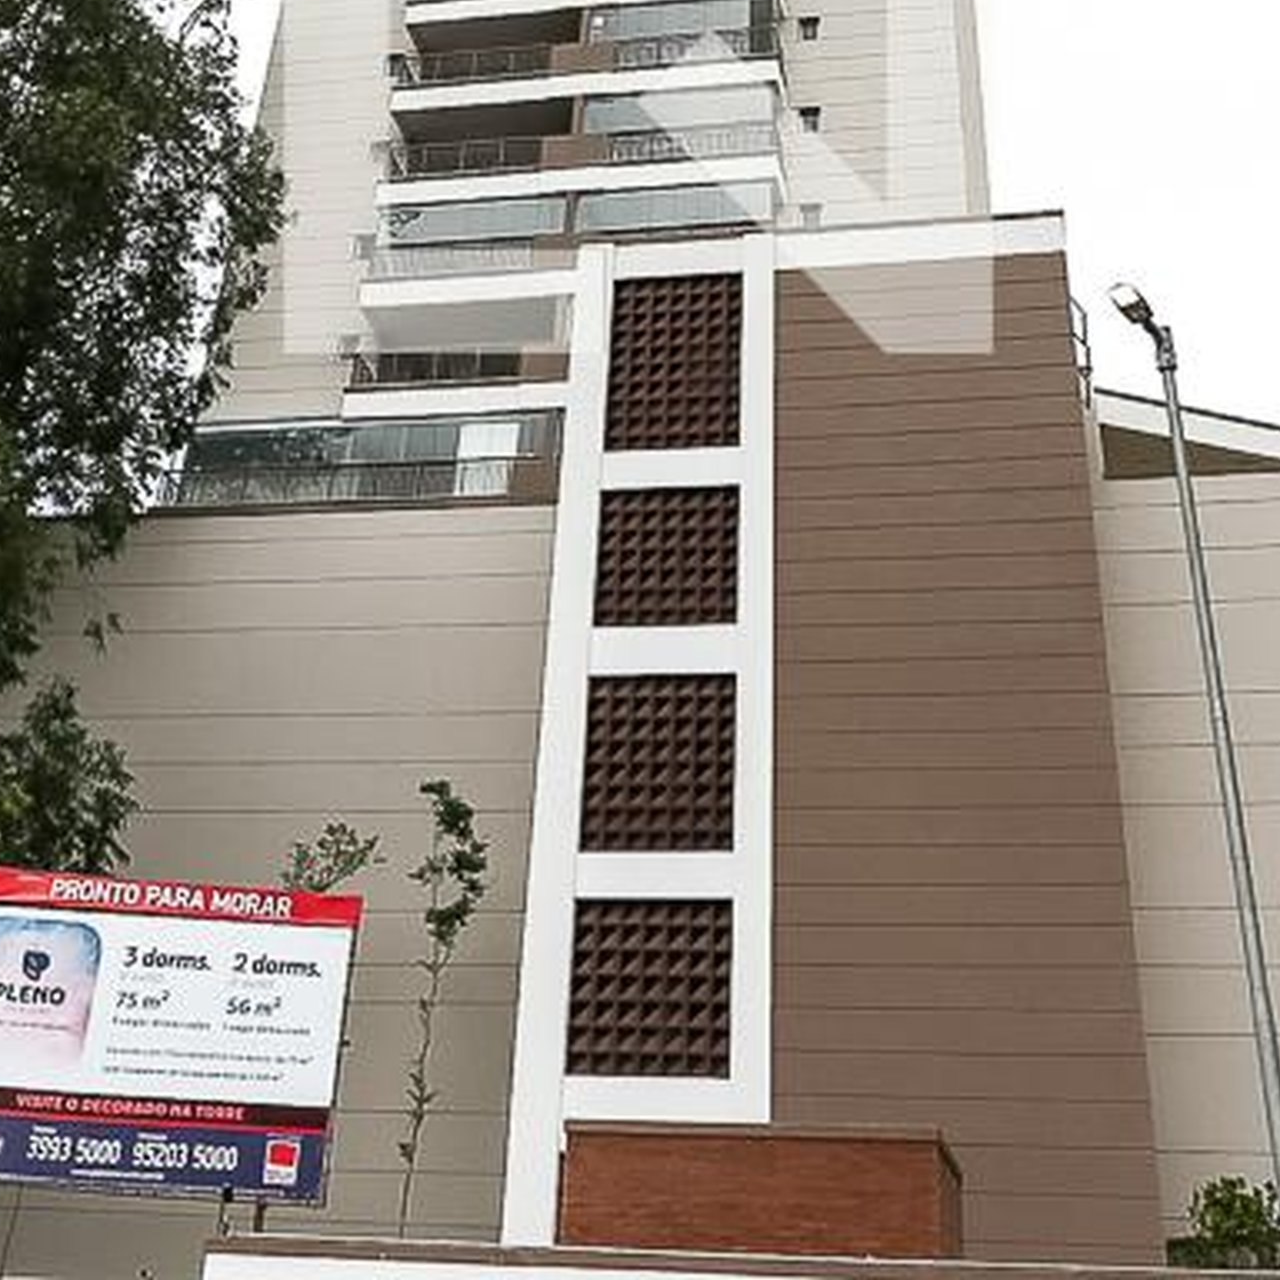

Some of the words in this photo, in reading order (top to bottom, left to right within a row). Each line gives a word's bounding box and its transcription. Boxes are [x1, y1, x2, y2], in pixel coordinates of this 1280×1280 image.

[50, 877, 141, 904] PRONTO
[144, 885, 205, 911] PARA
[209, 888, 293, 919] MORAR
[123, 946, 139, 968] 3
[142, 947, 212, 971] dorms.
[232, 951, 249, 974] 2
[251, 954, 322, 978] dorms.
[116, 991, 139, 1009] 75
[15, 1093, 63, 1111] VISITE
[65, 1098, 78, 1112] O
[81, 1099, 168, 1117] DECORADO
[169, 1105, 193, 1118] NA
[194, 1105, 245, 1120] TORRE
[25, 1134, 72, 1162] 3993
[74, 1138, 122, 1165] 5000
[132, 1141, 189, 1169] 95203
[191, 1144, 239, 1171] 5000
